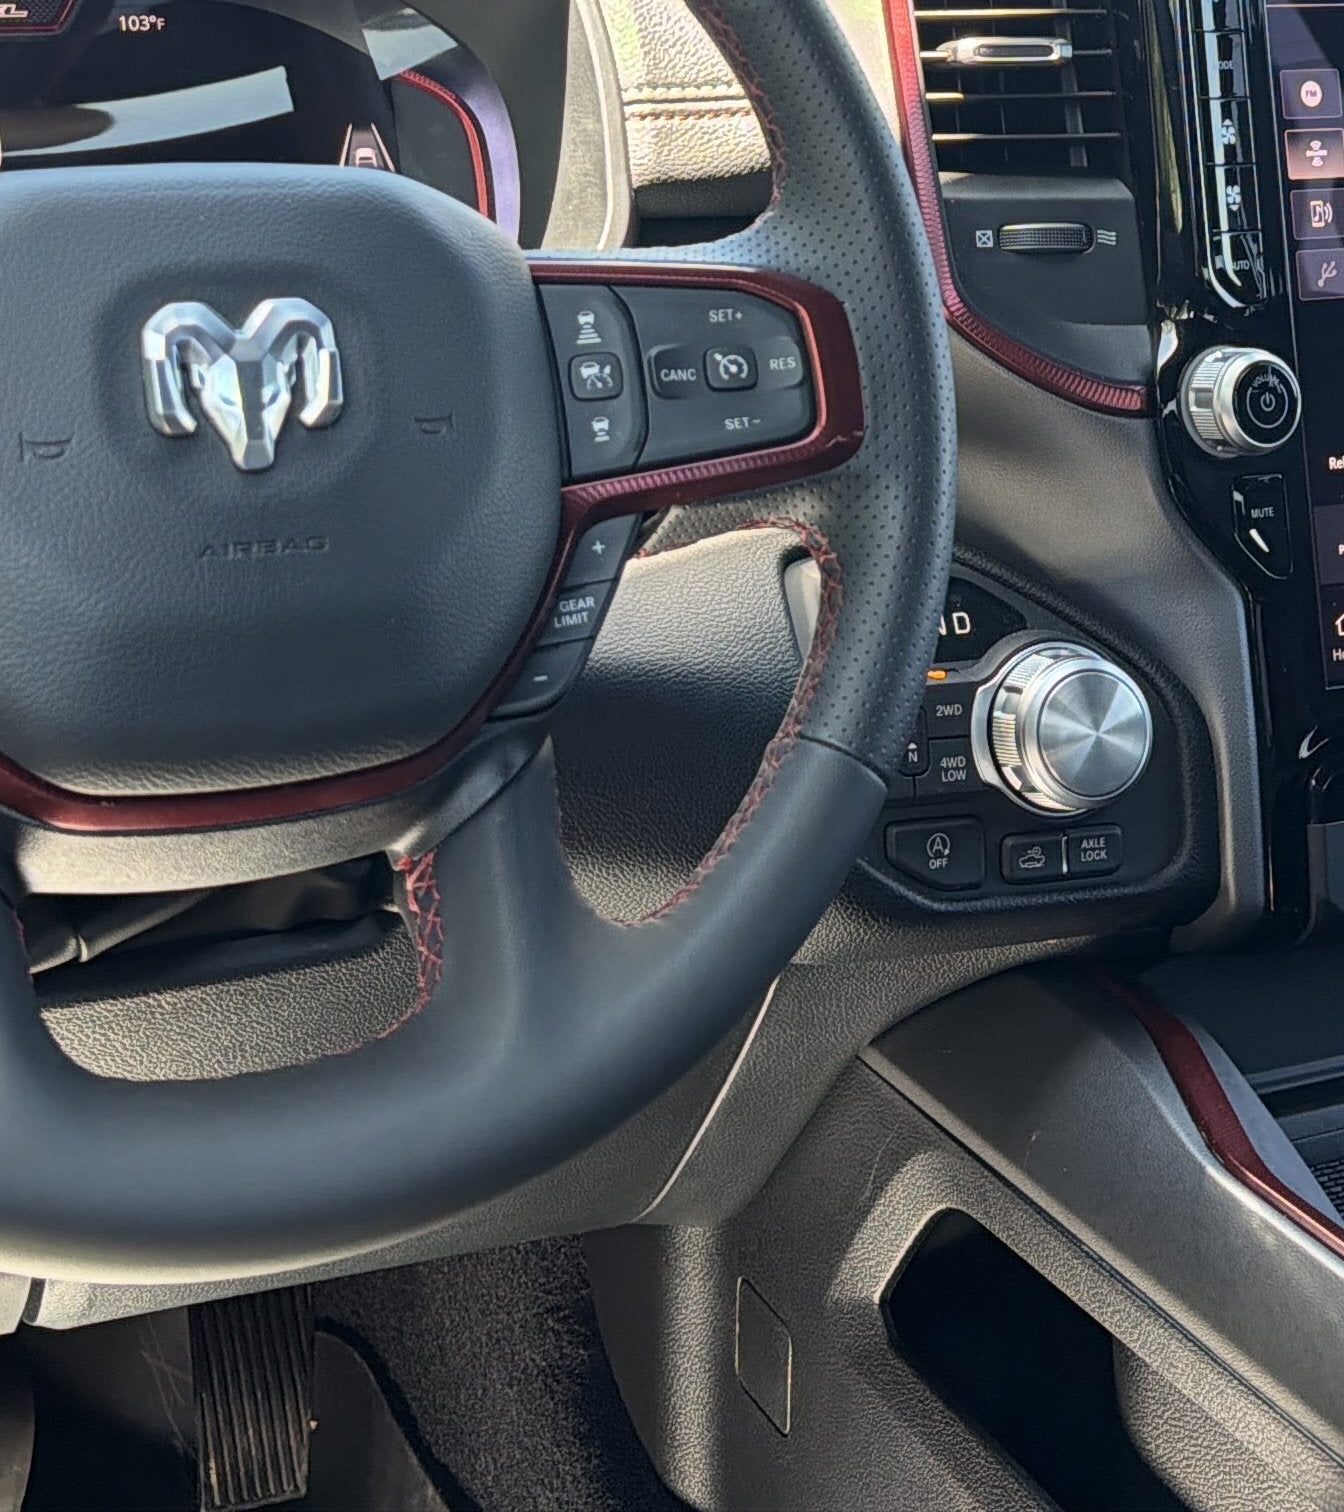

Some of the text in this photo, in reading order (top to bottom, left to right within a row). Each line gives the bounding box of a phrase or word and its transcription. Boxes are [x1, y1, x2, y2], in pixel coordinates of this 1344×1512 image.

[769, 355, 797, 371] RES
[660, 368, 697, 383] CANC
[1251, 506, 1275, 519] MUTE
[199, 535, 330, 559] AIRBAG
[559, 595, 596, 612] GEAR
[554, 611, 590, 628] LIMIT
[952, 611, 972, 635] D
[935, 704, 963, 717] 2WD
[908, 750, 918, 763] N
[940, 756, 967, 768] 4WD
[941, 769, 967, 783] LOW
[1080, 837, 1107, 849] AXLE
[1080, 849, 1107, 862] LOCK
[928, 858, 949, 870] OFF
